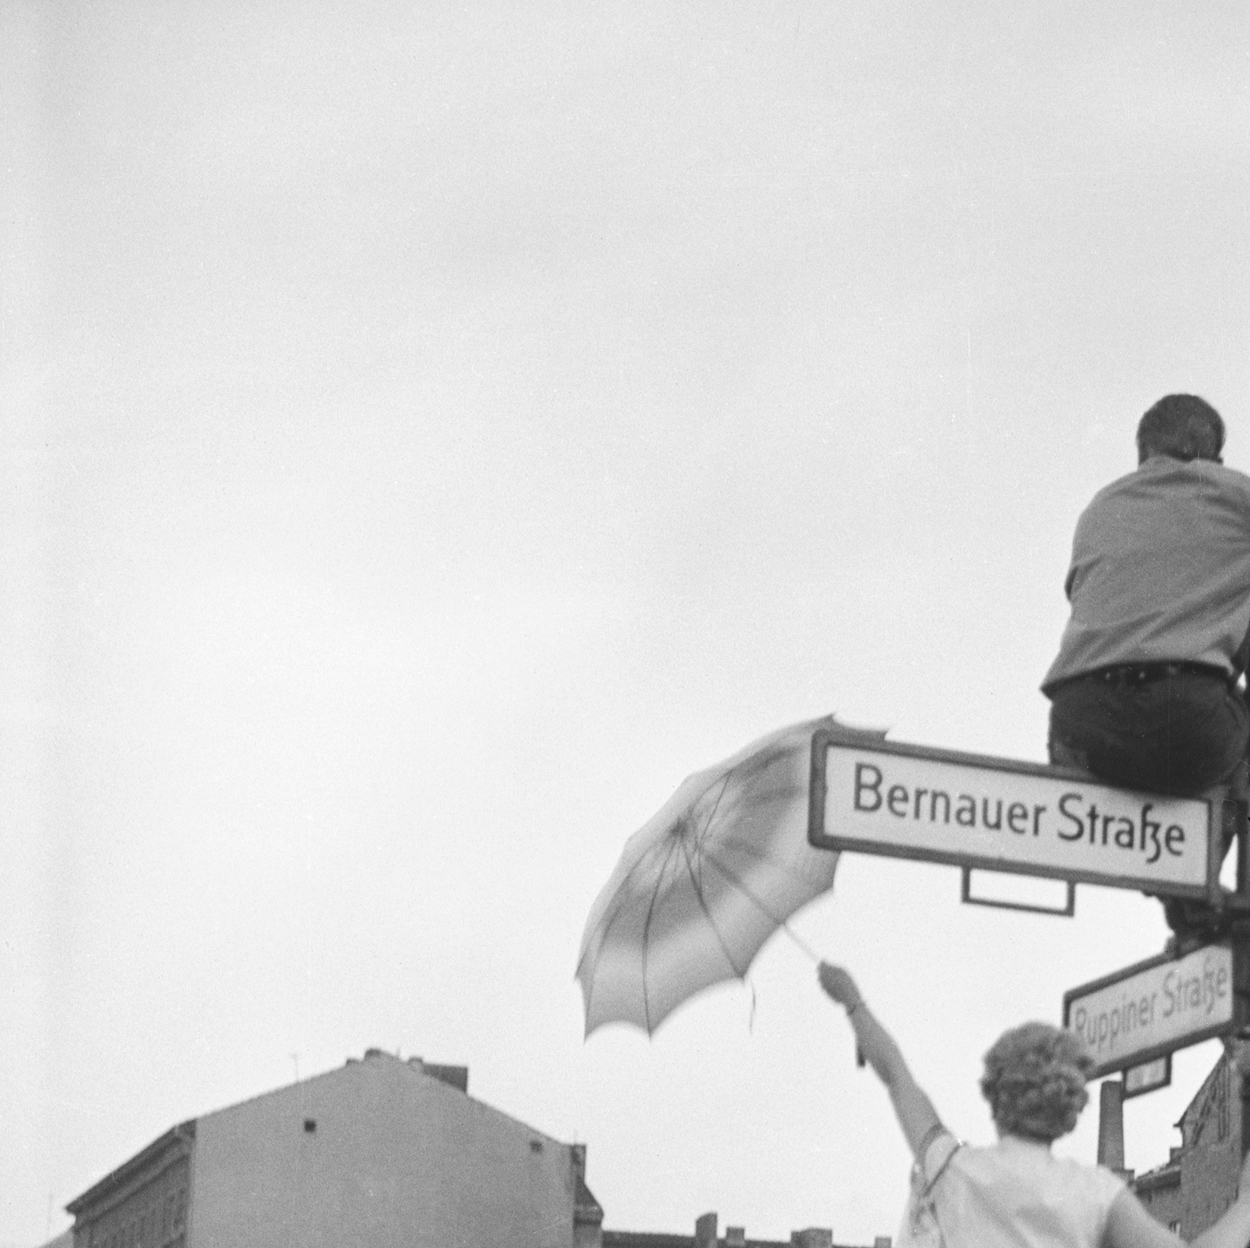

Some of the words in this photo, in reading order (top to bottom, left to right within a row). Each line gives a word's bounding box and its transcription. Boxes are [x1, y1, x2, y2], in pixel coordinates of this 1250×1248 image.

[853, 762, 1046, 836] Bernauer
[1058, 793, 1186, 864] Straße
[1162, 954, 1228, 1018] Straße
